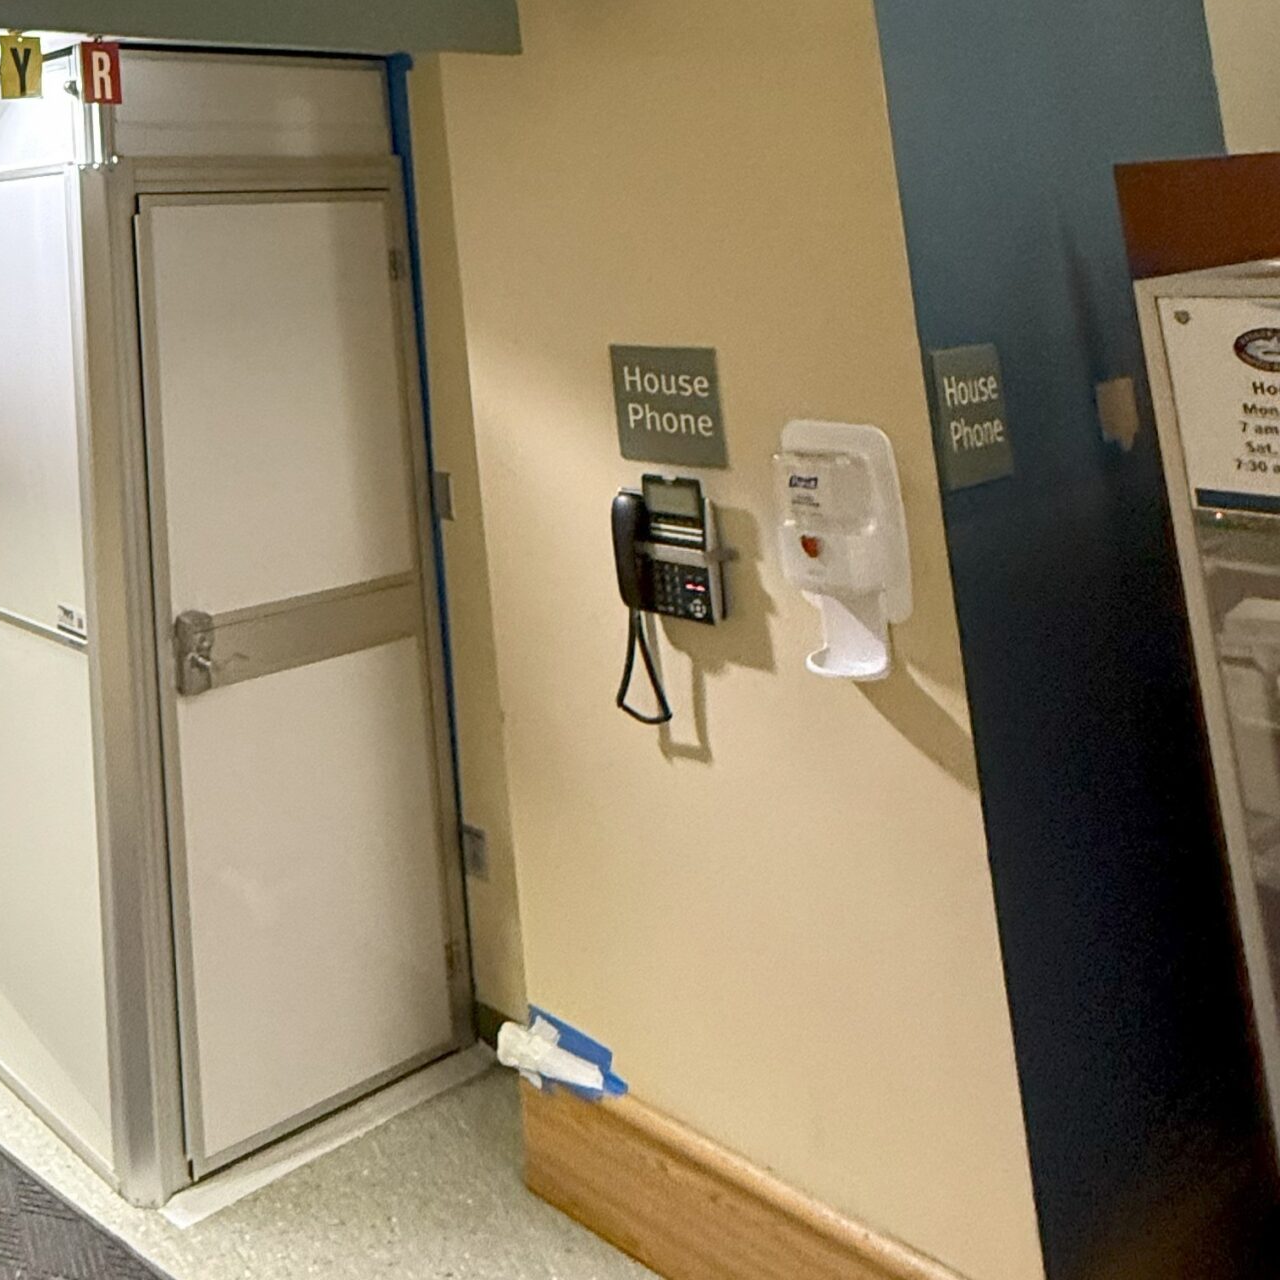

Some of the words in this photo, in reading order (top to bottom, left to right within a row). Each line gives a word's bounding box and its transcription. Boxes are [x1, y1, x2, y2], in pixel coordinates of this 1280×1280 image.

[10, 47, 32, 96] Y
[92, 51, 112, 99] R
[623, 366, 710, 397] House
[944, 375, 999, 408] House
[1252, 381, 1280, 395] Ho
[628, 403, 713, 436] Phone
[950, 418, 1006, 452] Phone
